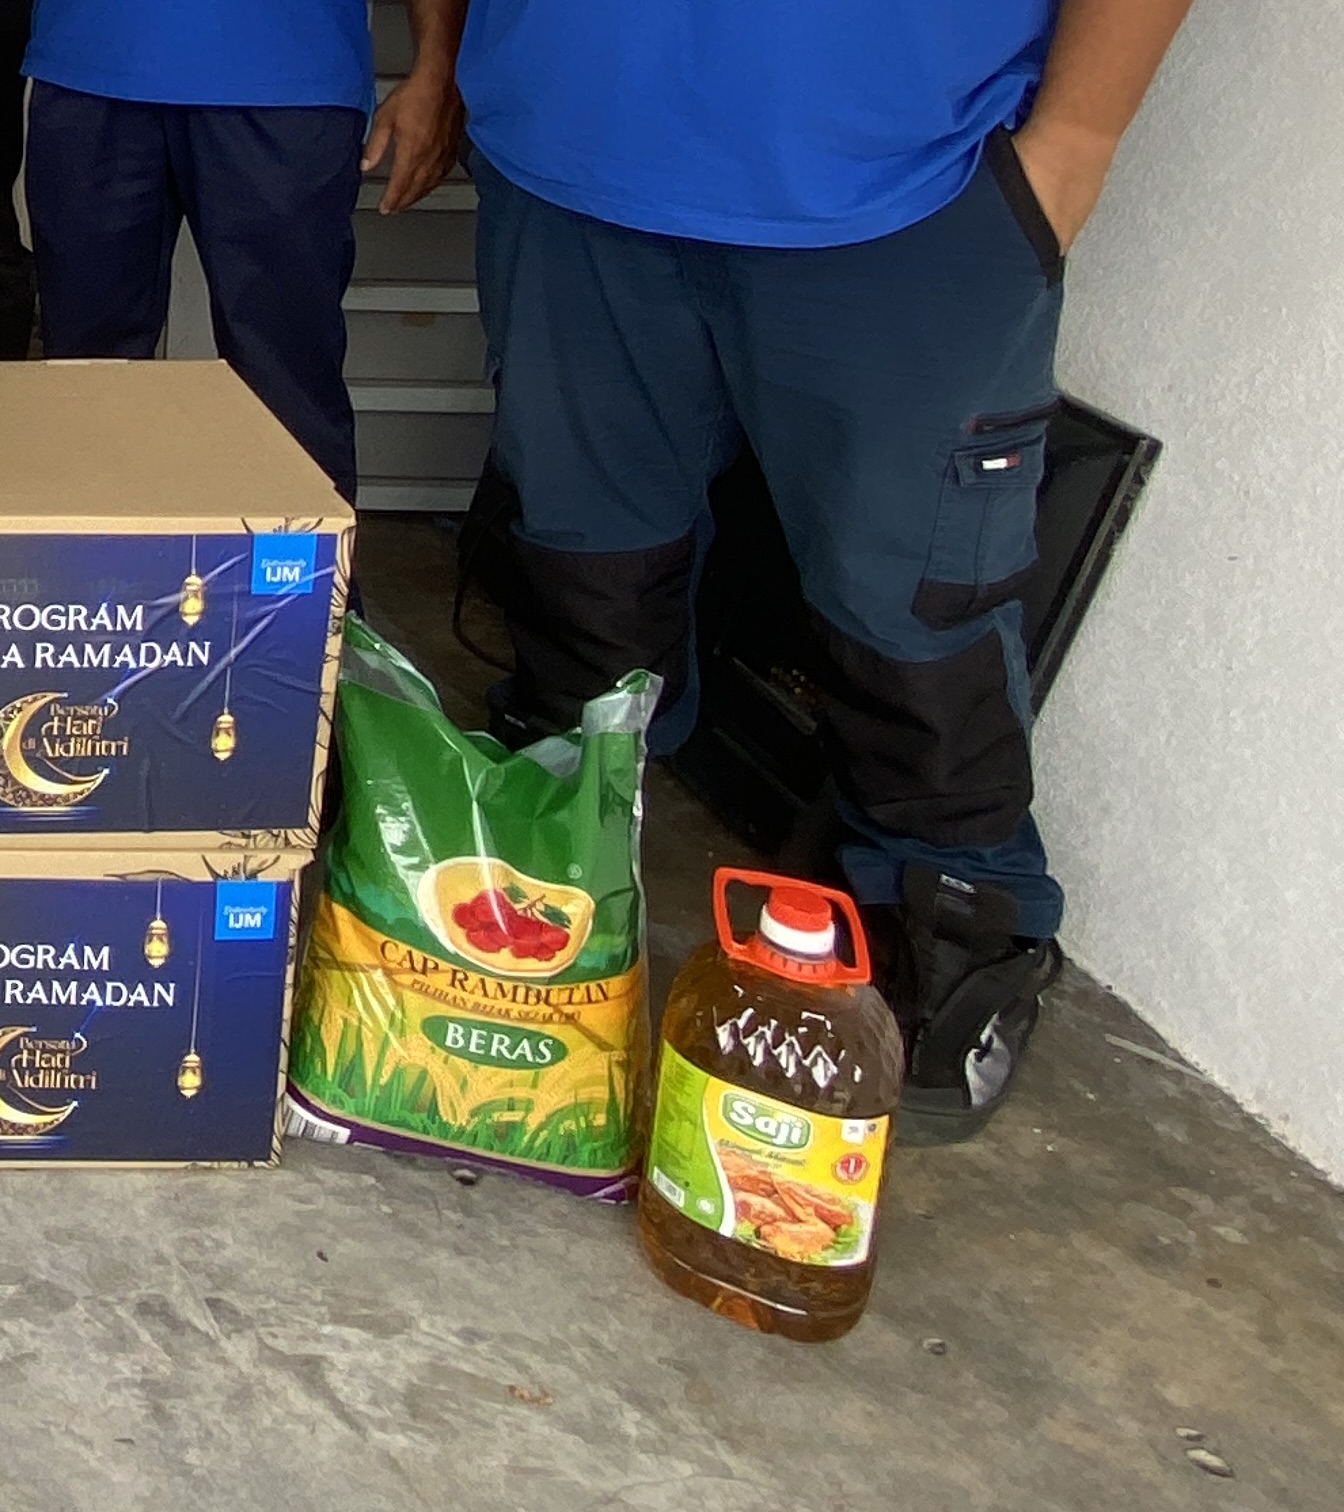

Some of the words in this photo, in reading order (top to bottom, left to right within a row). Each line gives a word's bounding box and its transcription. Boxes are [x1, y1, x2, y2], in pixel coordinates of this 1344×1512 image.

[265, 566, 300, 583] IJM
[34, 640, 211, 669] RAMADAN
[228, 912, 262, 929] IJM
[380, 940, 440, 977] CAP
[448, 967, 611, 1007] RAMBUTAN
[4, 978, 176, 1007] RAMADAN
[444, 1022, 554, 1064] BERAS
[729, 1100, 803, 1145] Saji
